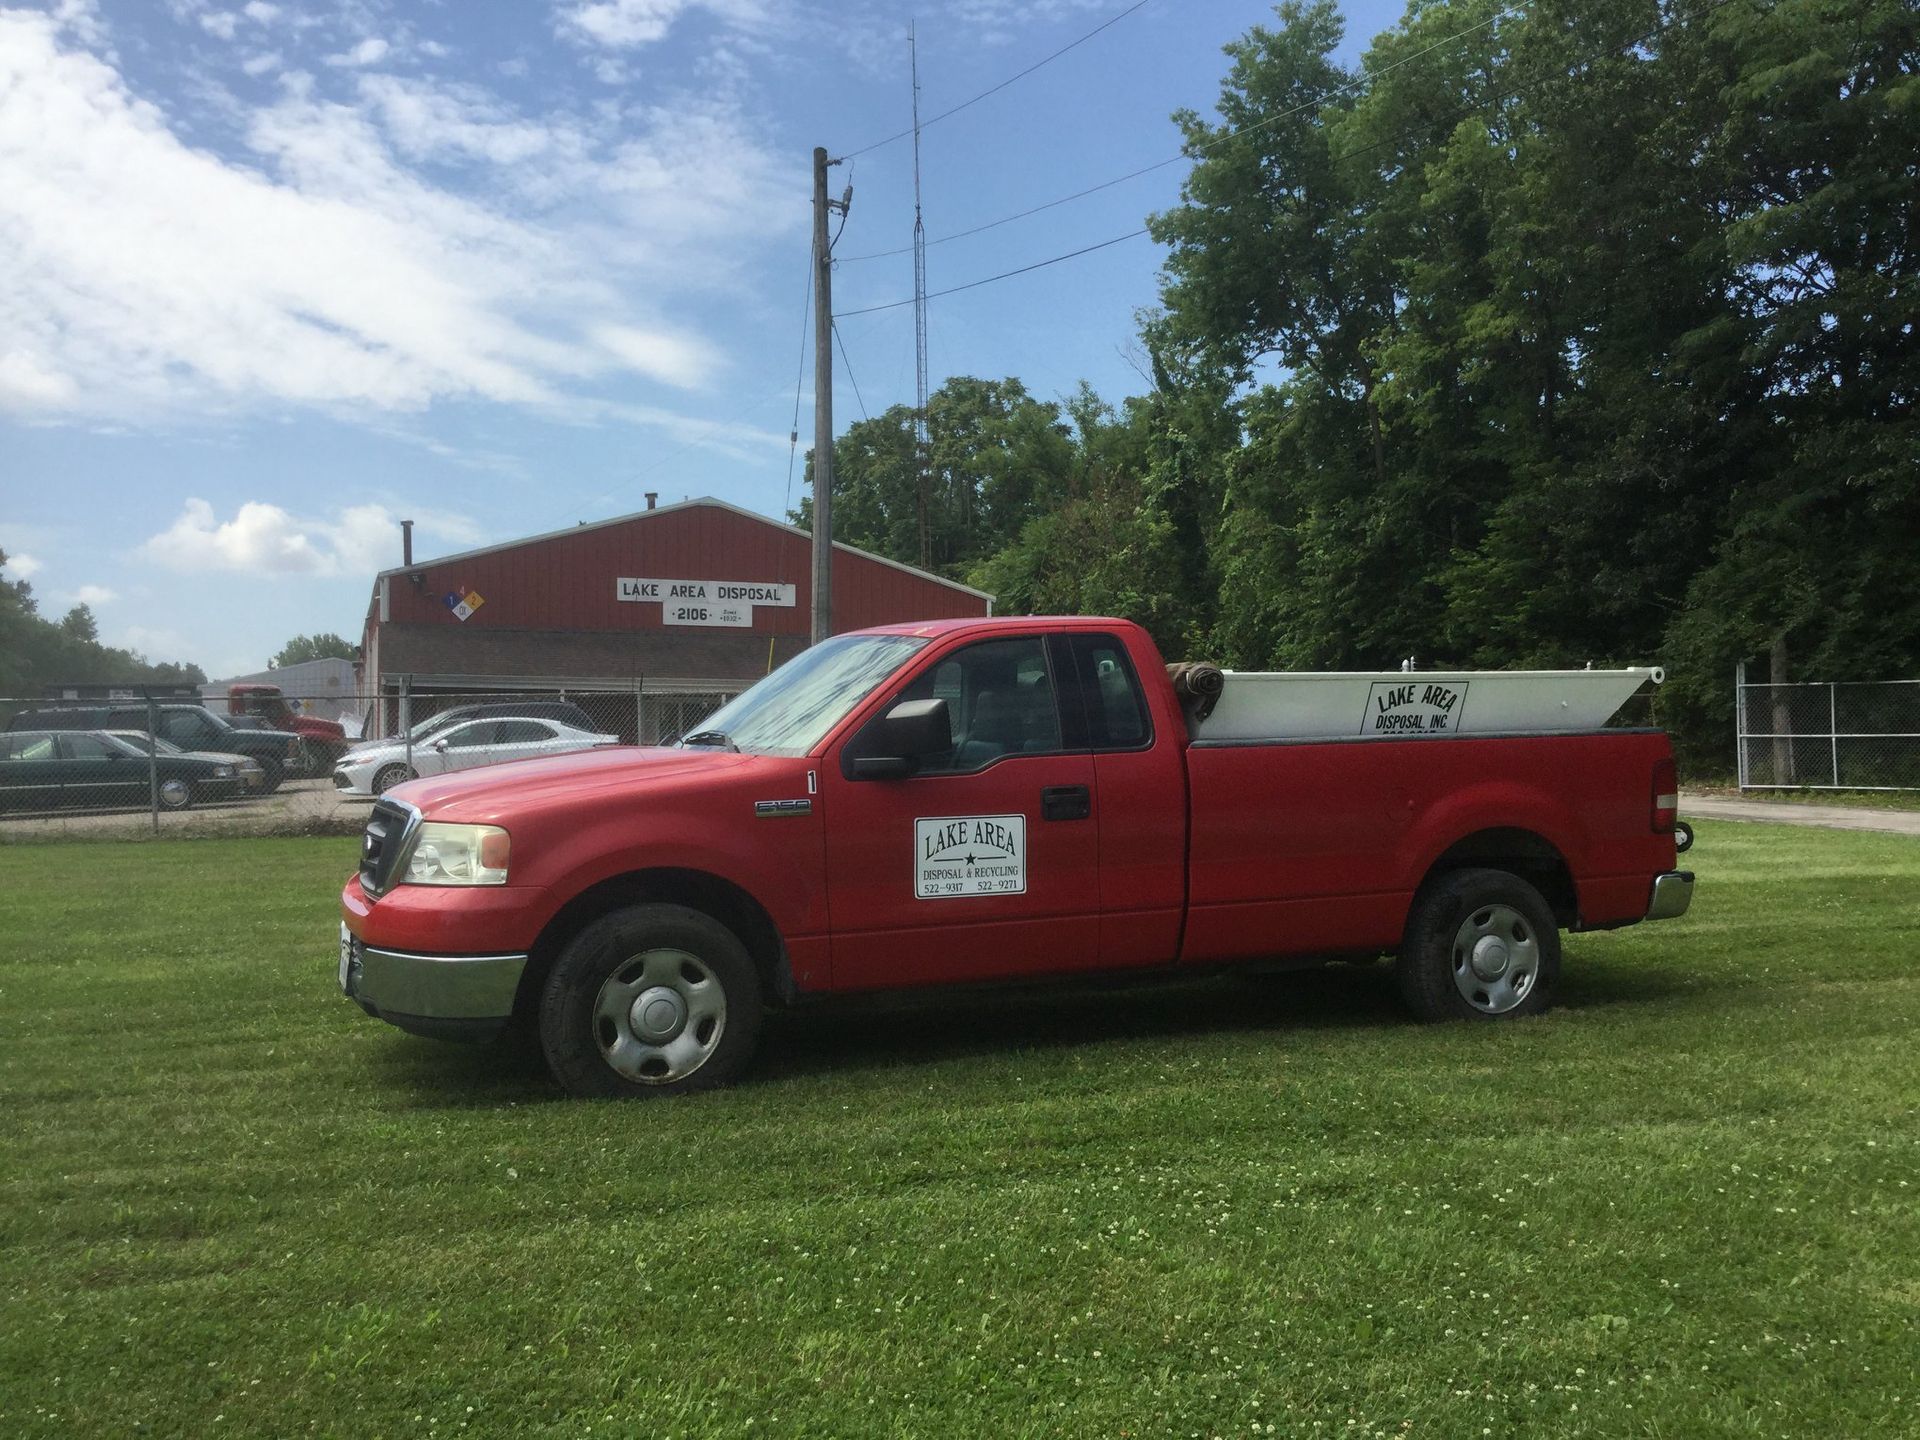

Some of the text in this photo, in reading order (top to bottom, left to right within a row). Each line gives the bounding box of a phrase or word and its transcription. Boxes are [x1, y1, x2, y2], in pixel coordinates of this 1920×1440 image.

[623, 583, 781, 601] LAKE AREA DISPOSAL
[678, 608, 708, 621] 2106
[1378, 685, 1458, 713] LAKE AREA
[809, 771, 815, 792] 1
[925, 821, 1016, 861] LAKE AREA
[923, 866, 1018, 881] DISPOSAL & RECYCLING
[924, 880, 1017, 893] 522-9317 522-9271
